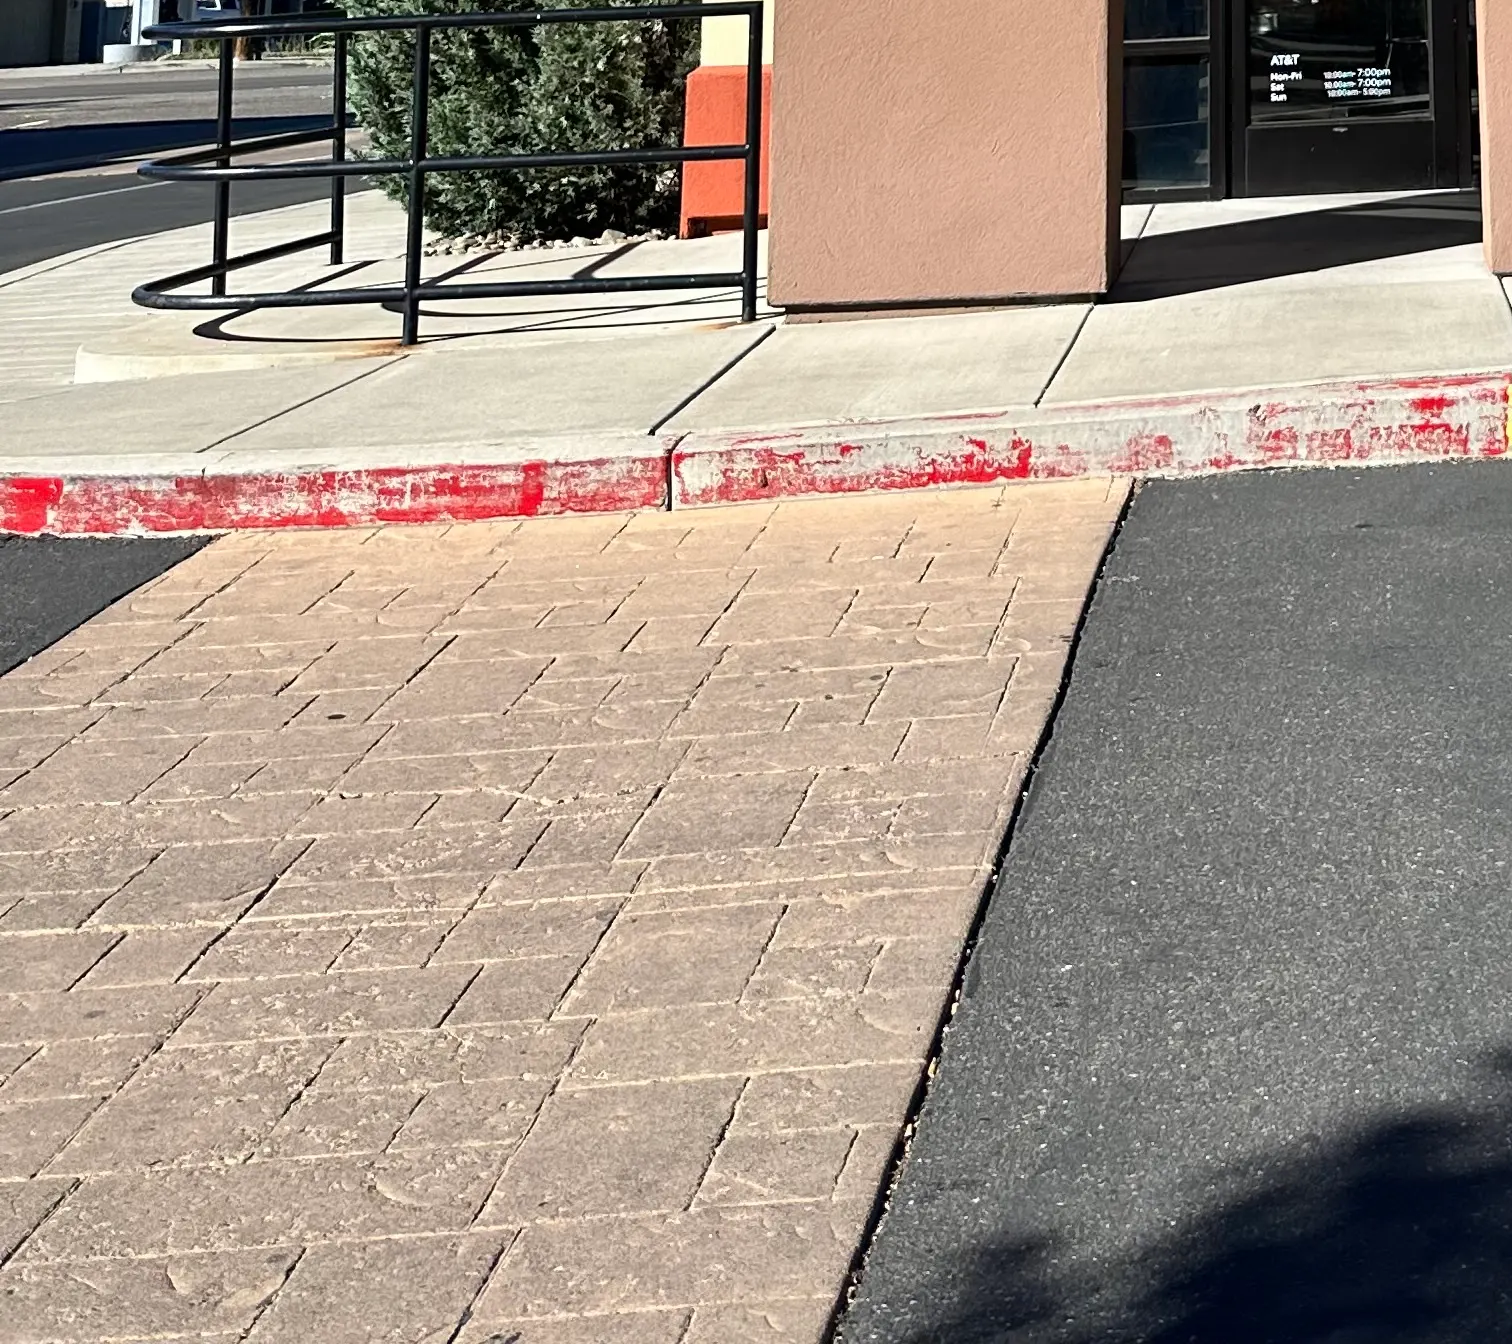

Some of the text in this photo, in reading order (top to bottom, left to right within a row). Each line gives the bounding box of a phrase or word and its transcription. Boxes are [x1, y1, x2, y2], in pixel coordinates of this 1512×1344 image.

[1270, 54, 1300, 66] AT&T
[1270, 71, 1302, 81] Mon-Fri
[1357, 68, 1391, 77] 7:00pm
[1270, 82, 1285, 92] Sat
[1357, 78, 1391, 87] 7:00pm
[1270, 92, 1287, 102] Sun
